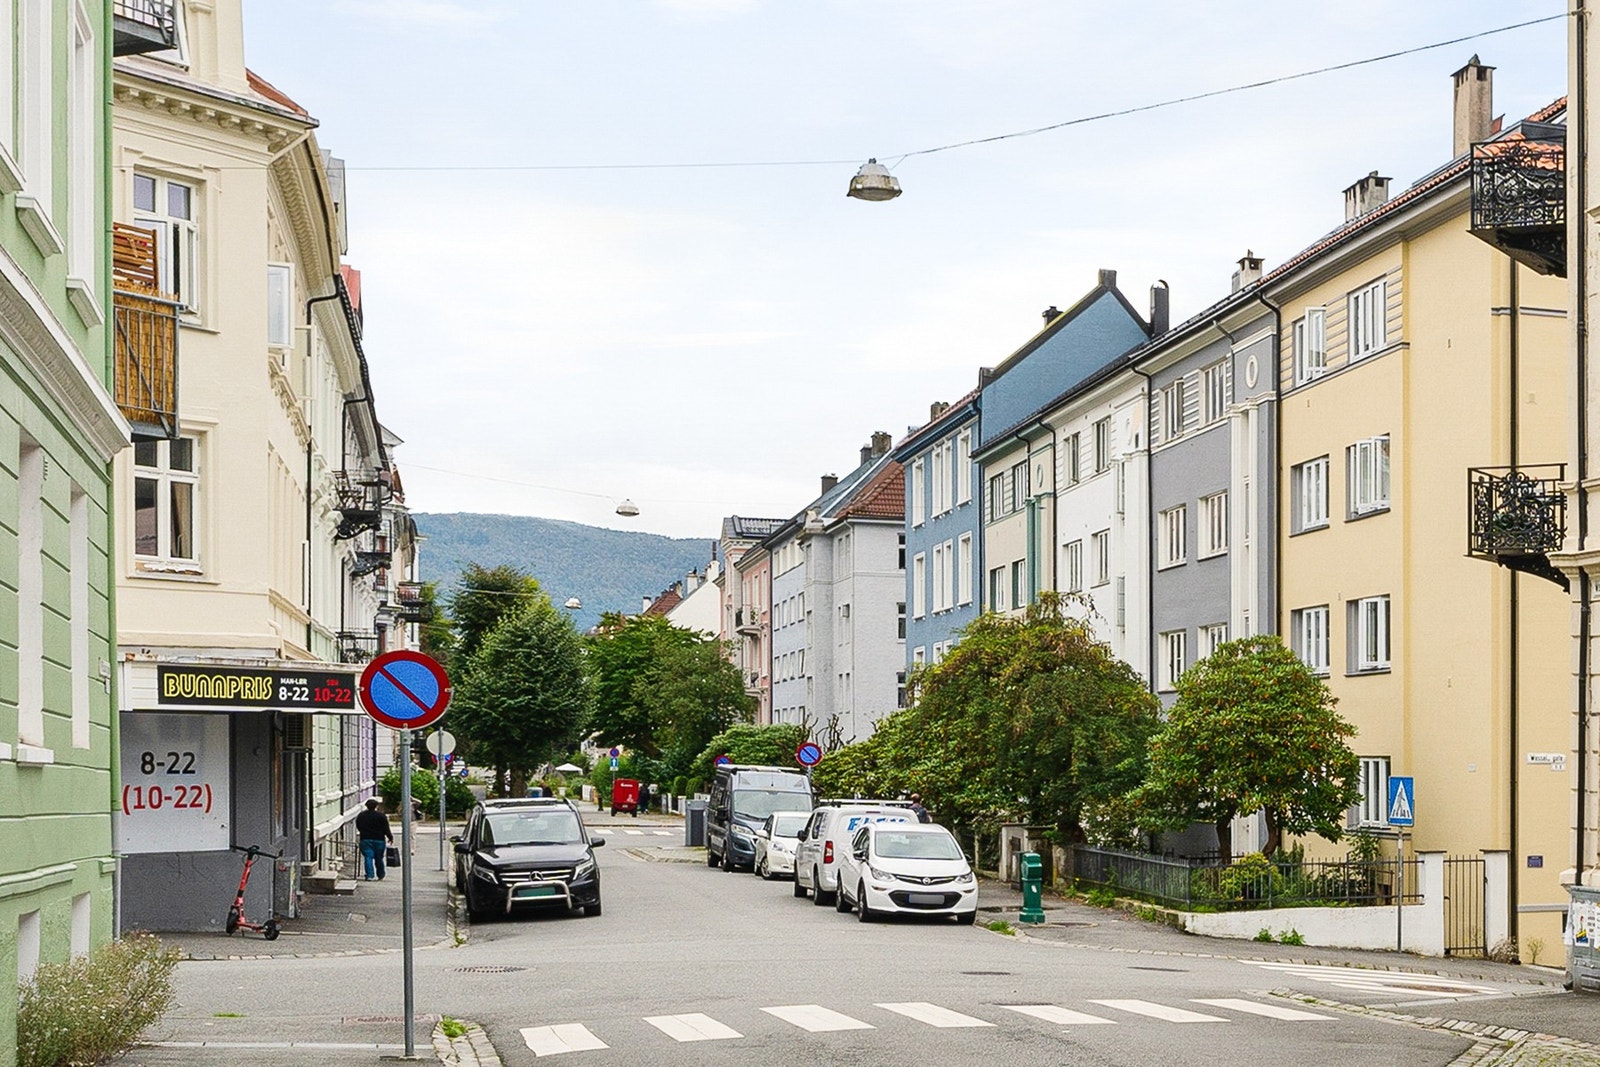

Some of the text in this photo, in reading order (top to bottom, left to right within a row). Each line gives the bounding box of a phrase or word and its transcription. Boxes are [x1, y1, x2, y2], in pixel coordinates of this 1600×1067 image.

[163, 673, 273, 700] BUNNPRIS
[278, 686, 309, 701] 8-22
[314, 687, 351, 702] 10-22
[140, 751, 196, 775] 8-22
[122, 783, 213, 815] (10-22)
